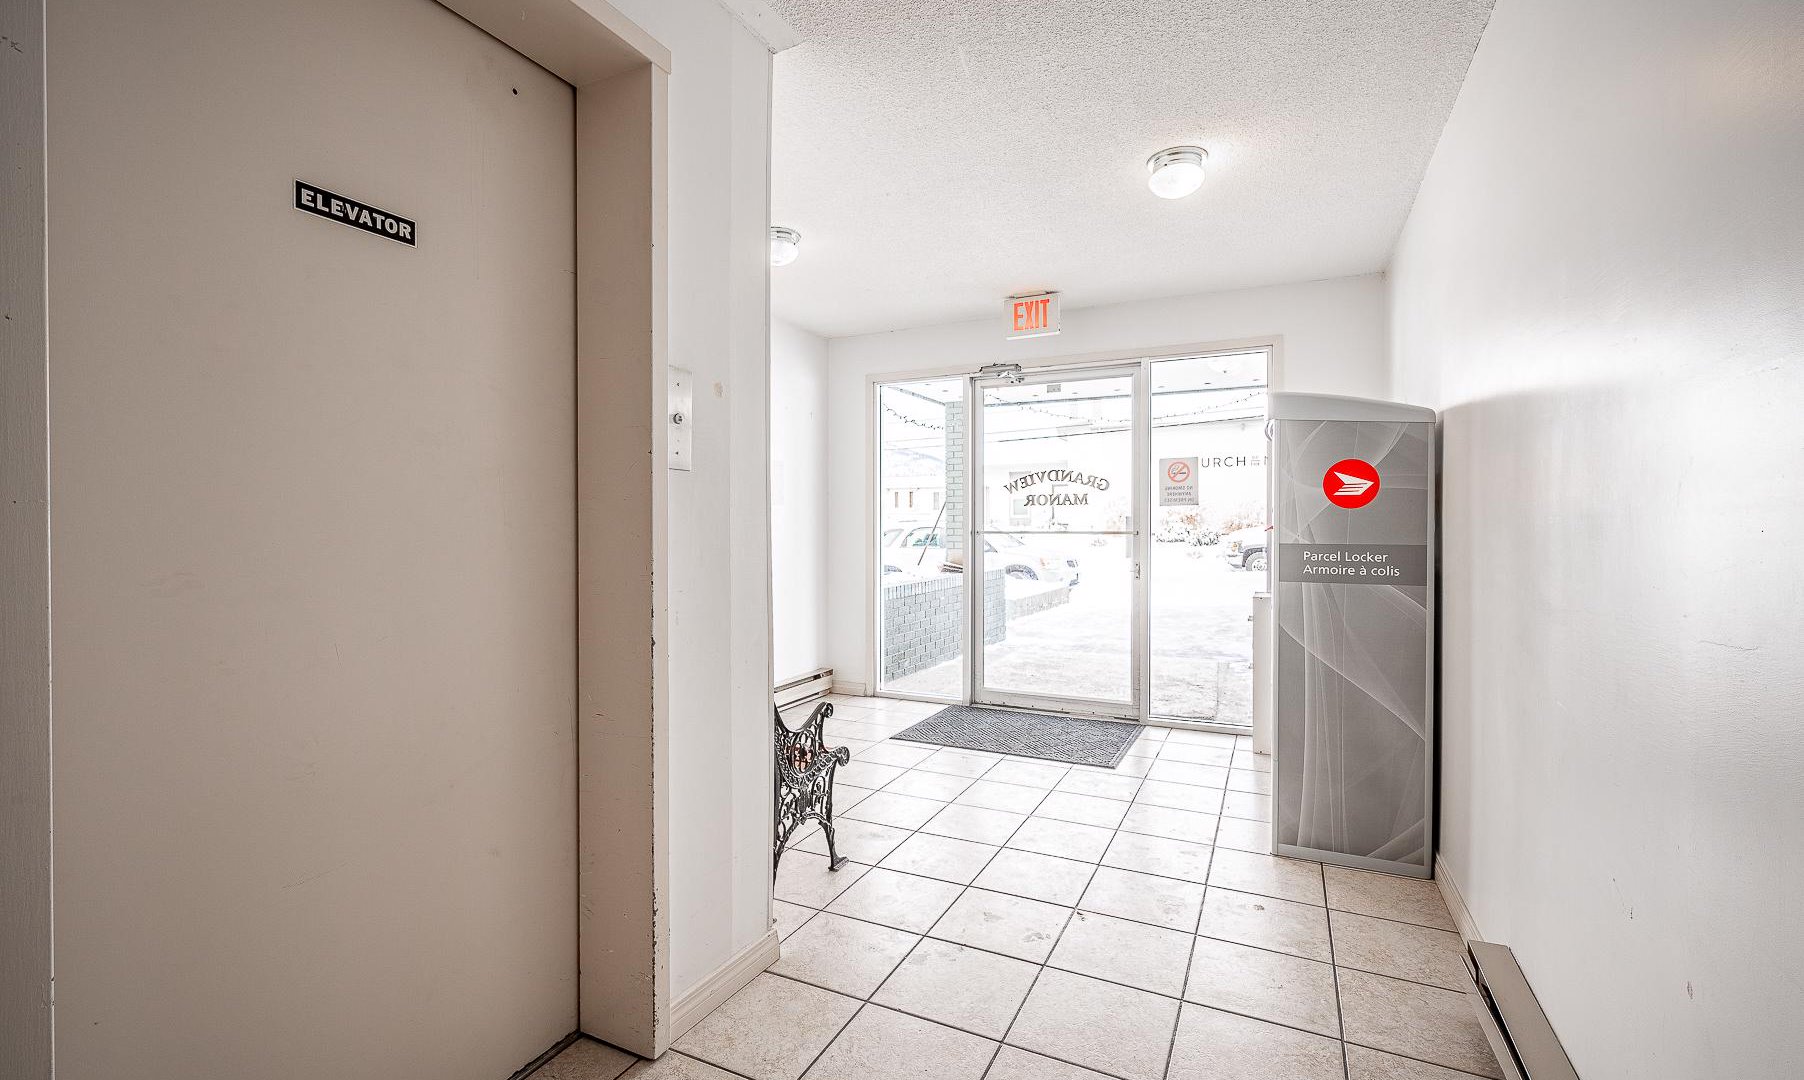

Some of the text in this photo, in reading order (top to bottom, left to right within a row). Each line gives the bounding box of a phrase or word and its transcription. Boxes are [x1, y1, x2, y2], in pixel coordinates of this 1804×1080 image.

[301, 187, 412, 240] ELEVATOR
[1013, 299, 1050, 331] EXIT
[1201, 456, 1246, 468] URCH
[1303, 551, 1389, 563] Parcel Locker
[1302, 564, 1400, 577] Armoire à colis
